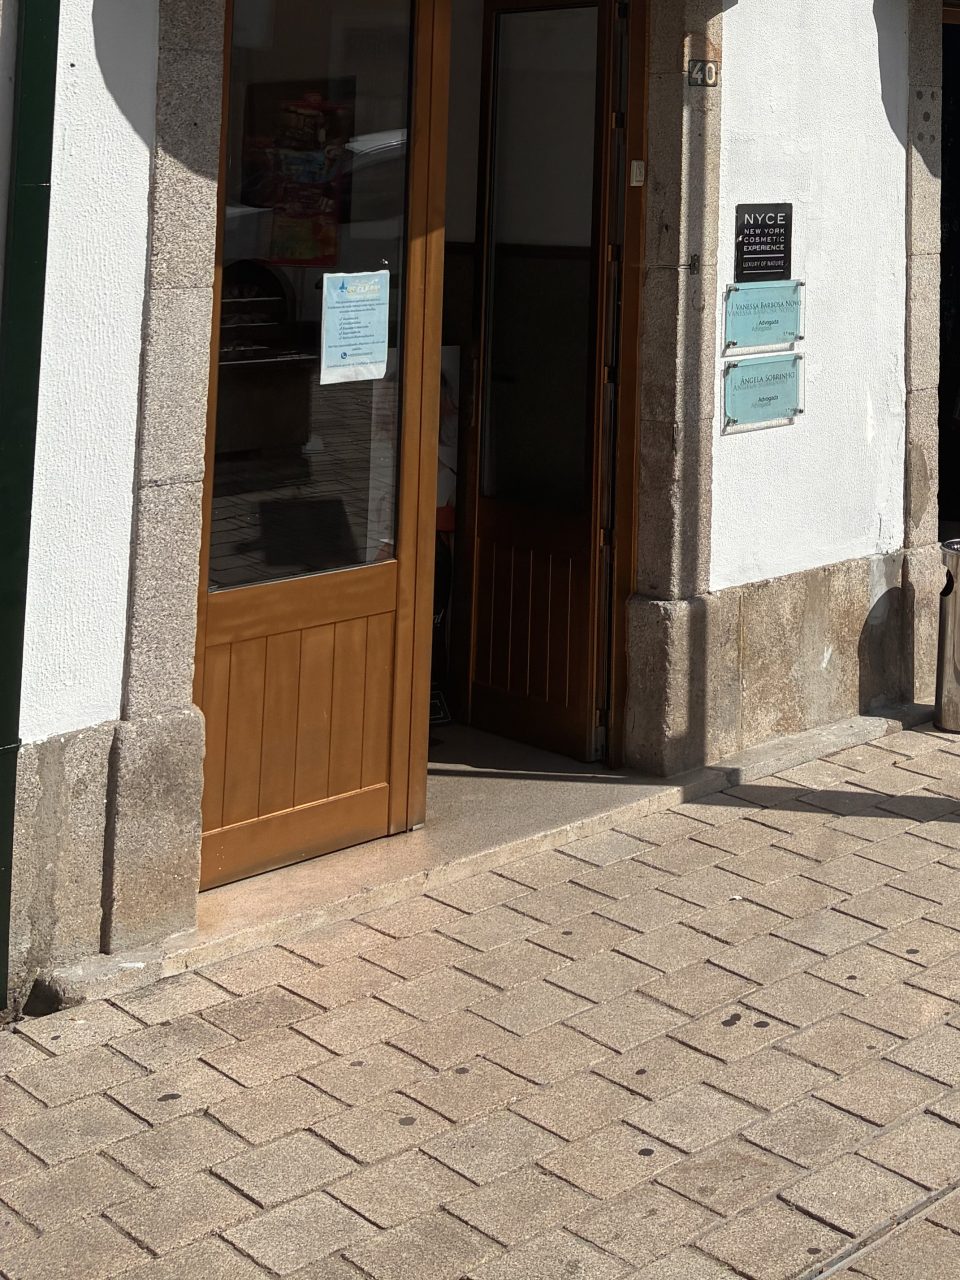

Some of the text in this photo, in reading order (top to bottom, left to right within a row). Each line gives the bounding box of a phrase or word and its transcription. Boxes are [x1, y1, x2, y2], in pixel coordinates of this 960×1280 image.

[691, 62, 716, 84] 40
[744, 213, 786, 225] NYCE
[743, 244, 785, 252] EXPERIENCE
